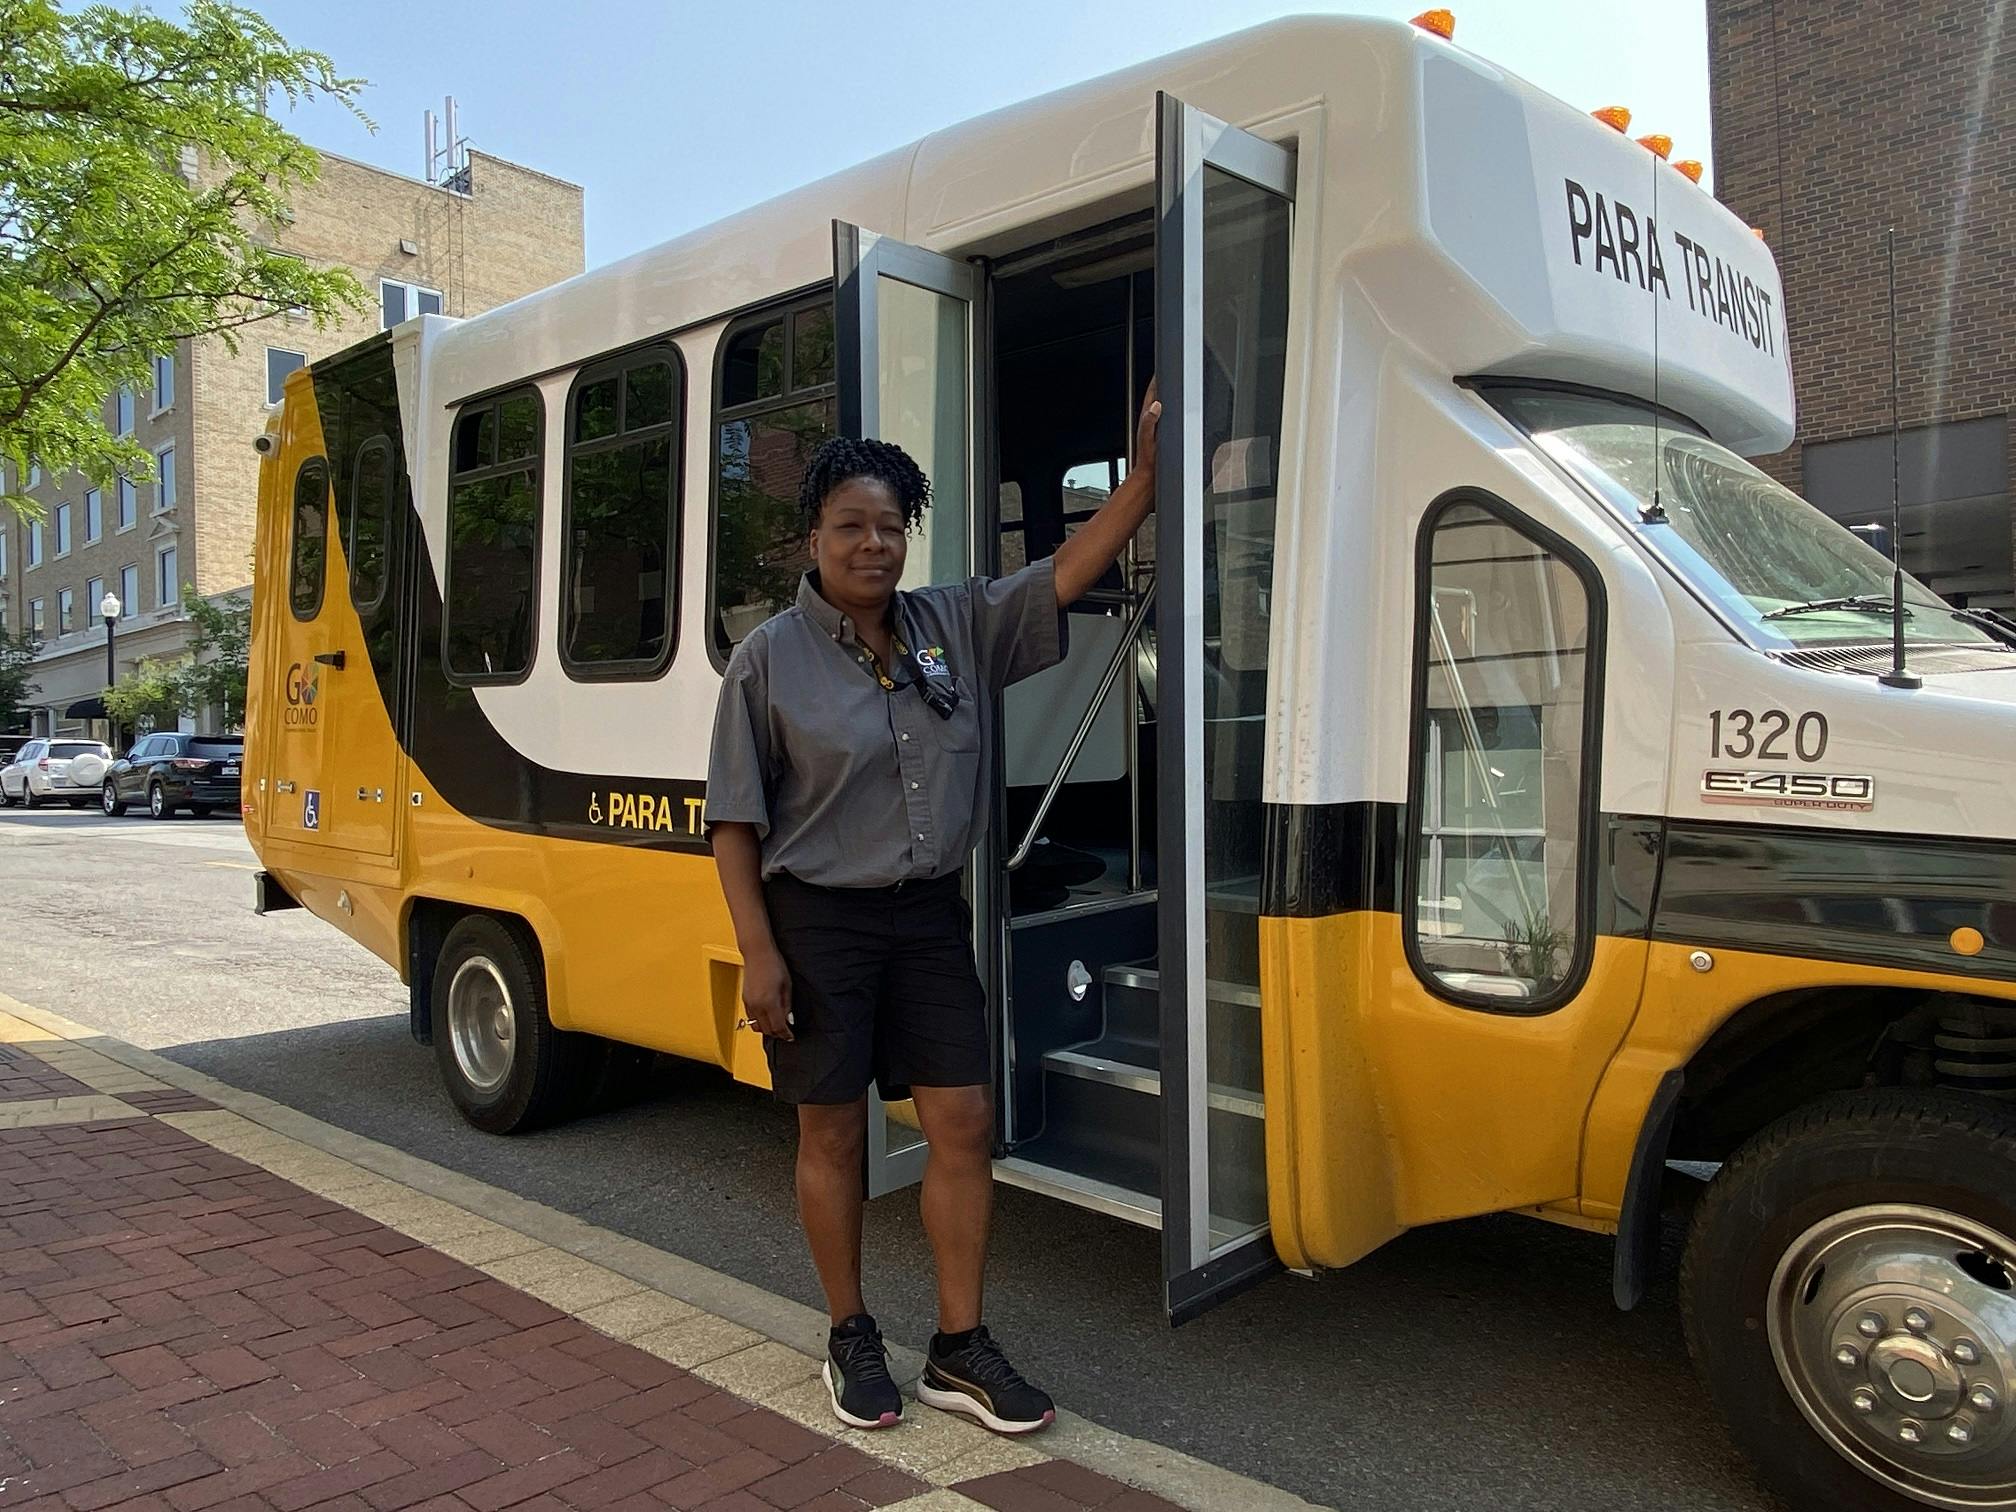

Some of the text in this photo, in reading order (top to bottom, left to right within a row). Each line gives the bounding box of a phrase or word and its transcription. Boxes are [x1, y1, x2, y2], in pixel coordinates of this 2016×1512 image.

[1564, 178, 1775, 358] PARA TRANSIT
[284, 707, 318, 725] COMO
[1709, 709, 1829, 763] 1320
[1705, 771, 1872, 798] E-450
[608, 792, 674, 833] PARA
